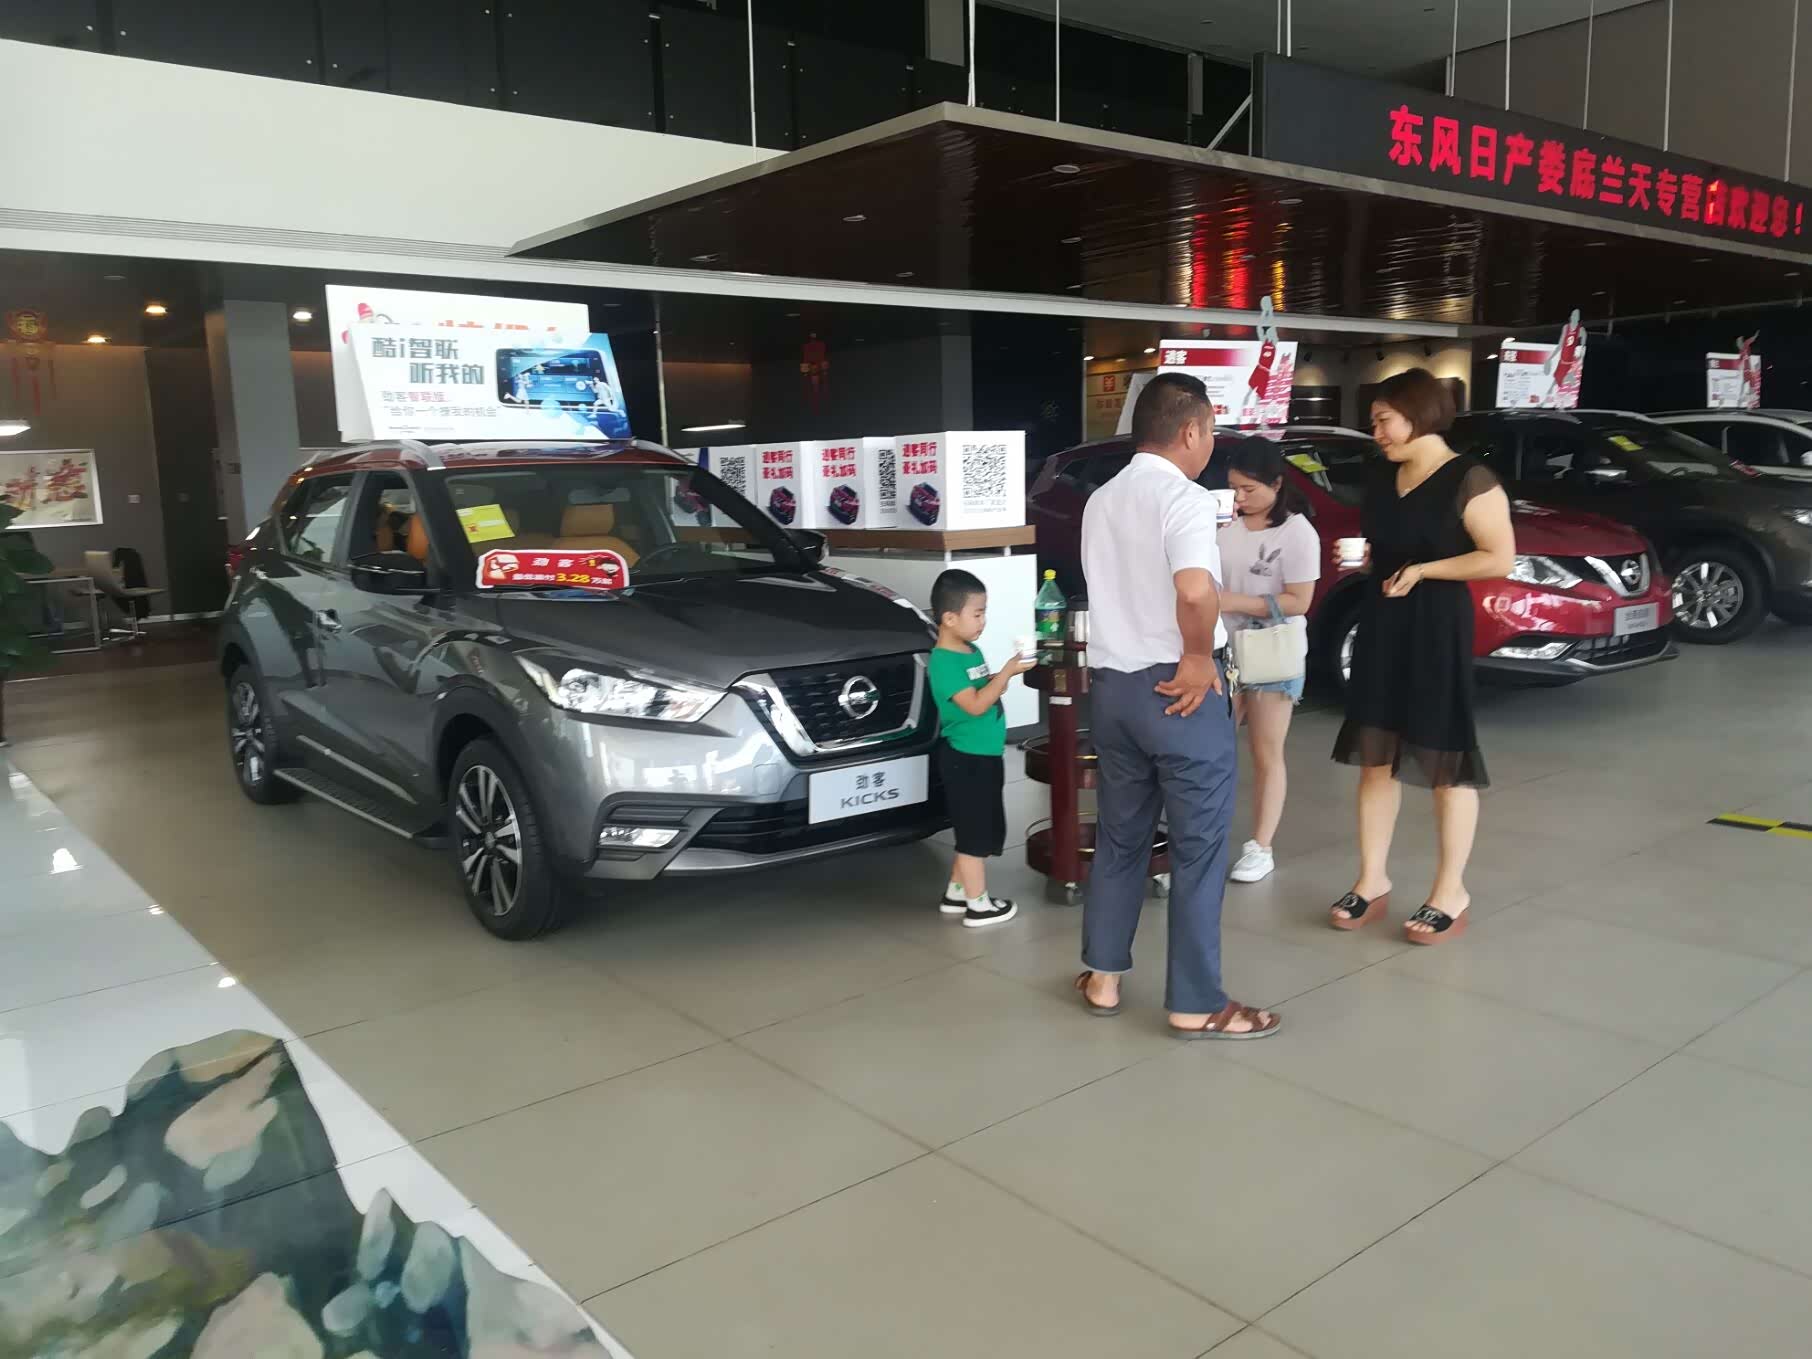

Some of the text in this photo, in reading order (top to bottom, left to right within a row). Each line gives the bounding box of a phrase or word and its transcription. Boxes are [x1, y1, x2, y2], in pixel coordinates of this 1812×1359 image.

[371, 337, 459, 359] 酷i智联
[409, 362, 485, 385] 听我的
[855, 771, 886, 790] 劲客
[840, 788, 900, 809] KICKS
